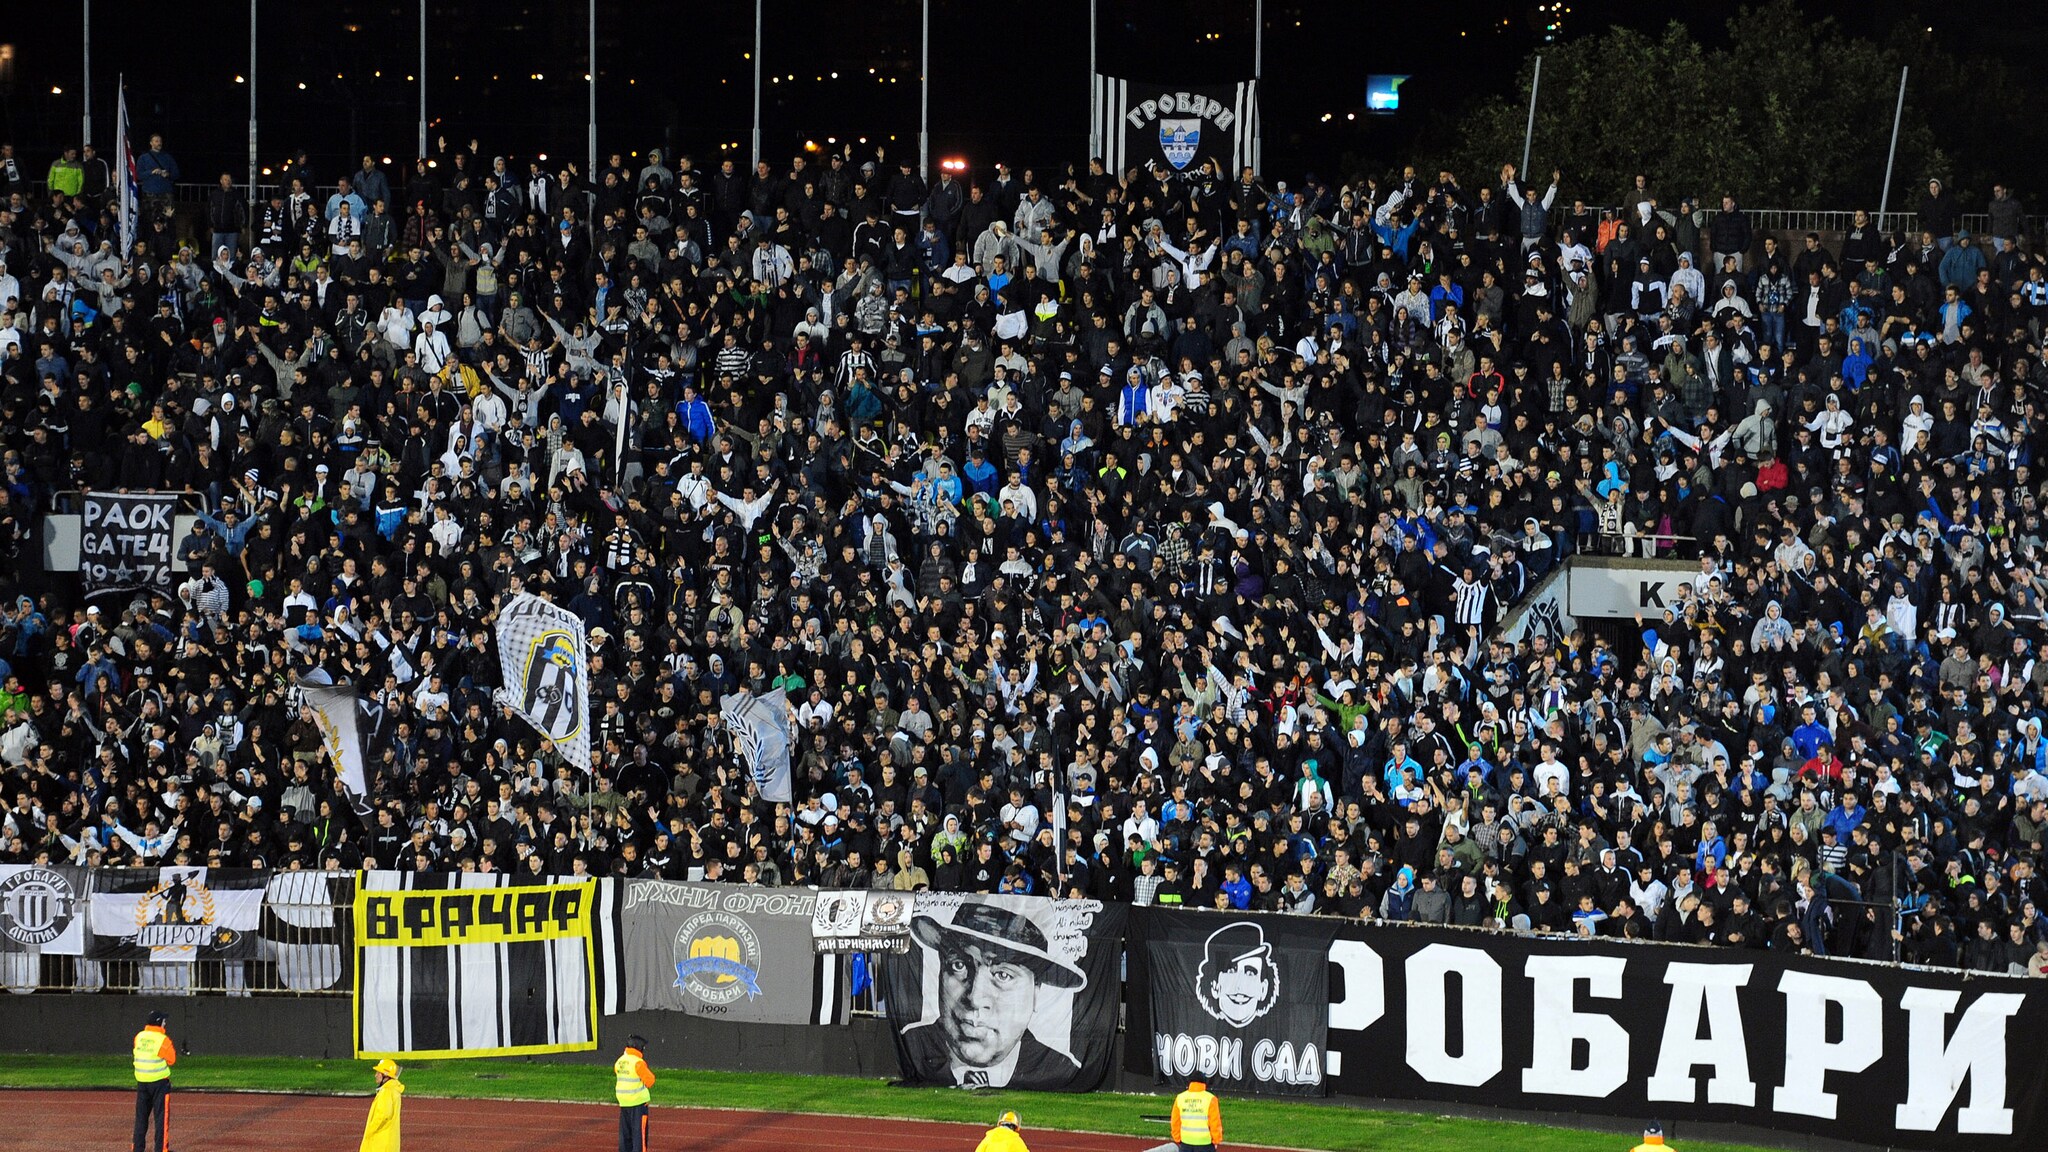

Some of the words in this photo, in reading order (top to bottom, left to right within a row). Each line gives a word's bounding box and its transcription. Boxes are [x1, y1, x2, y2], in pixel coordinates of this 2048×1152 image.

[1127, 92, 1235, 132] ГРОБАРИ
[84, 500, 172, 530] PAOK
[5, 870, 67, 891] ГРОБАРИ
[366, 888, 583, 939] ВРАЧАР
[9, 926, 59, 943] АПАТИН
[139, 926, 207, 945] ПИРОТ
[679, 913, 714, 945] НАПРЕД
[715, 913, 756, 956] ПАРТИЗАН
[817, 939, 836, 952] МИ
[688, 980, 742, 1000] ГРОБАРИ
[701, 1004, 728, 1014] 1999
[1155, 1032, 1243, 1081] НОВИ
[1251, 1038, 1322, 1086] САД
